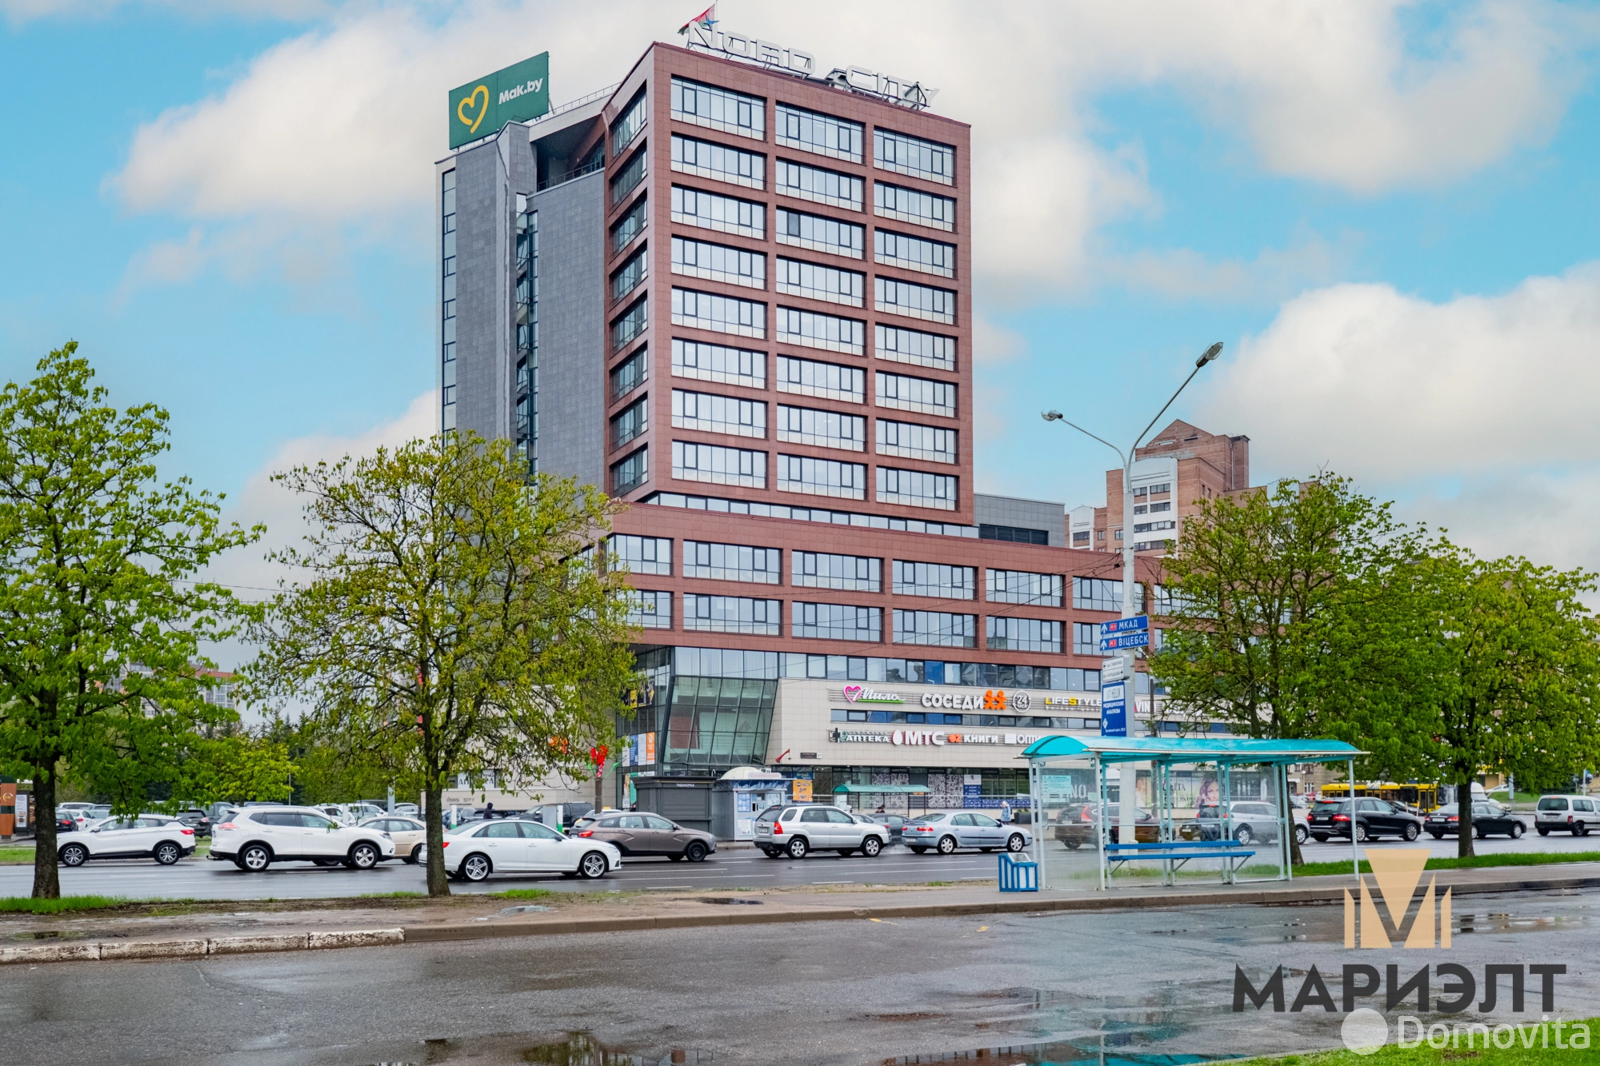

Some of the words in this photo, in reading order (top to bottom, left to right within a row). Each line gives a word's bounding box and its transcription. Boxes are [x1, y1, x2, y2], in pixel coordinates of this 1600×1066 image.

[689, 21, 816, 76] NORD
[846, 65, 940, 107] CITY
[1118, 619, 1138, 630] МКАД
[1118, 634, 1149, 647] ВІЦЕБСК
[921, 693, 984, 710] СОСЕДИ
[1045, 697, 1102, 706] LIFESTYLE
[846, 734, 890, 743] АПТЕКА
[903, 730, 945, 746] МТС
